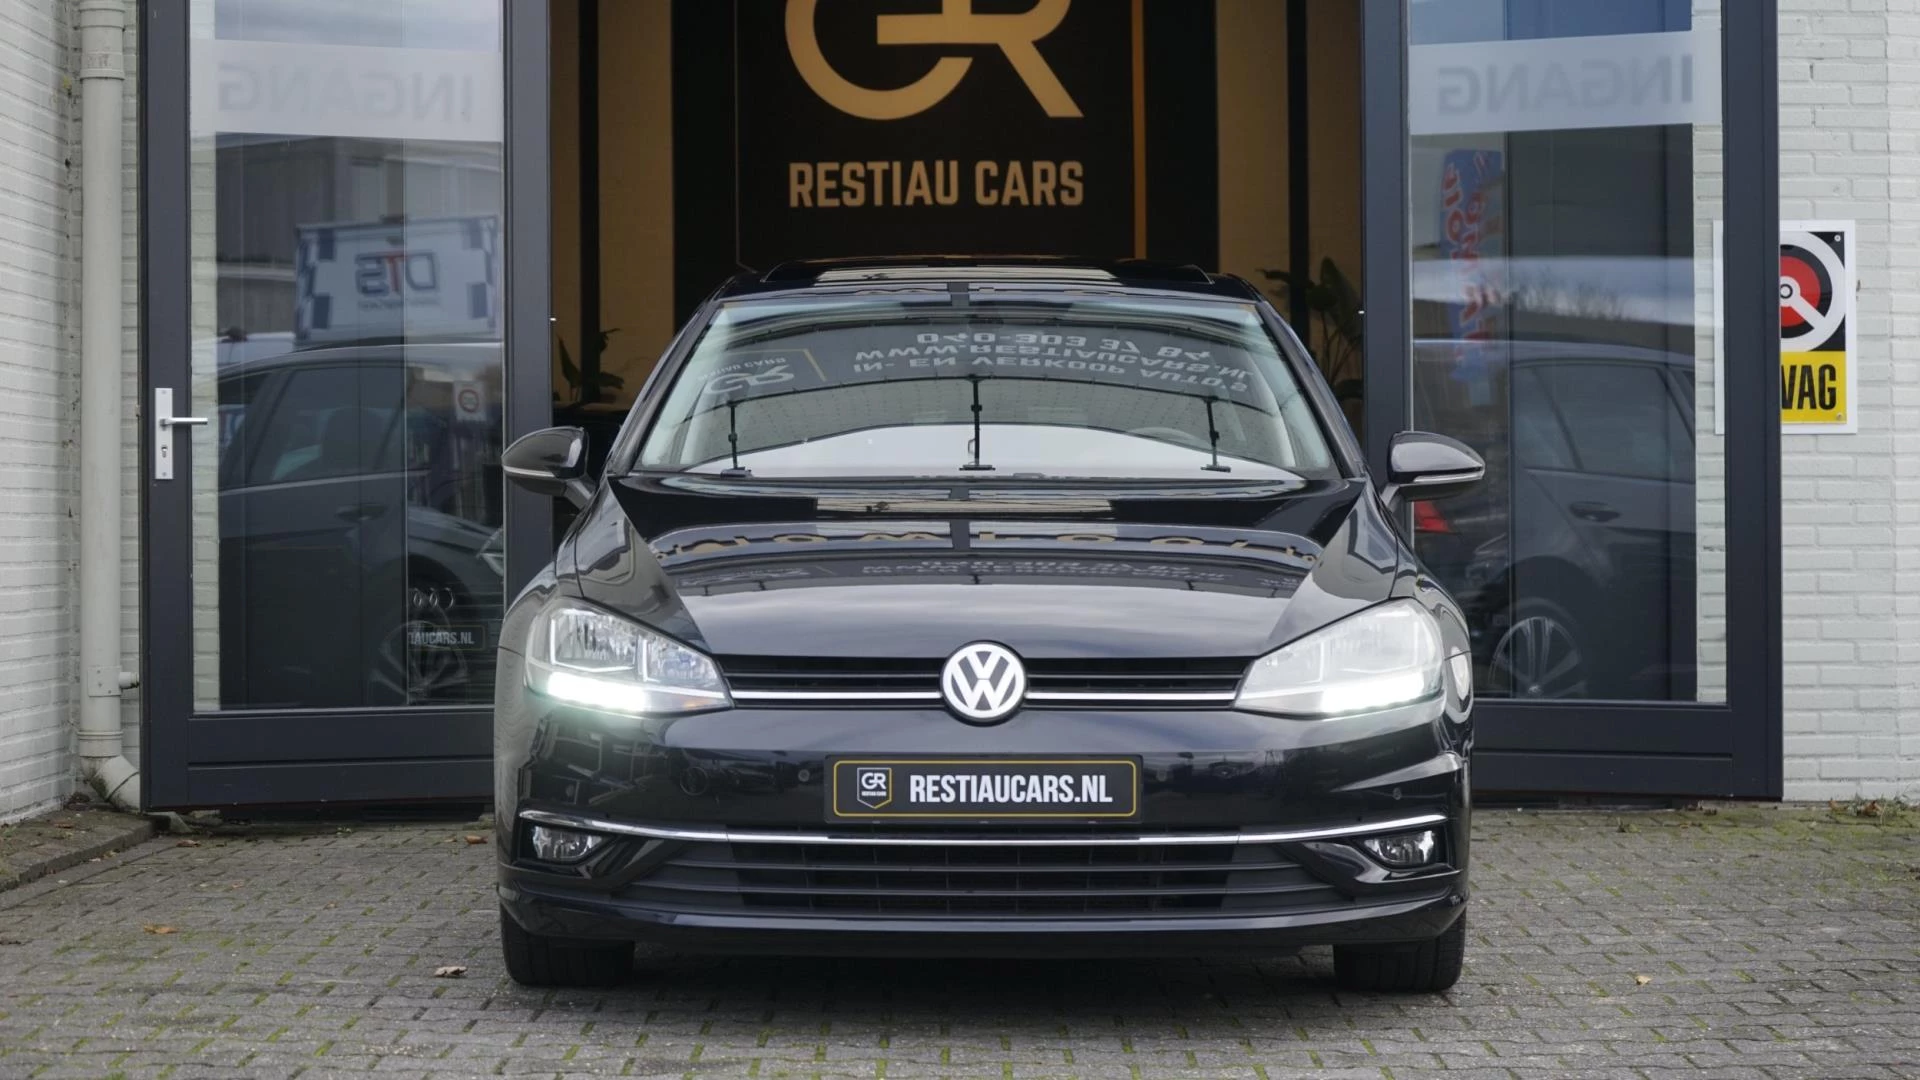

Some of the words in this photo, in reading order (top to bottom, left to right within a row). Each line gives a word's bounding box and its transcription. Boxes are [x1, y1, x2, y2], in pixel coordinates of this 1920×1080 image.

[789, 160, 958, 207] RESTIAU
[974, 160, 1084, 206] CARS
[1781, 364, 1837, 411] VAG
[861, 772, 887, 790] GR
[909, 774, 1113, 803] RESTIAUCARS.NL
